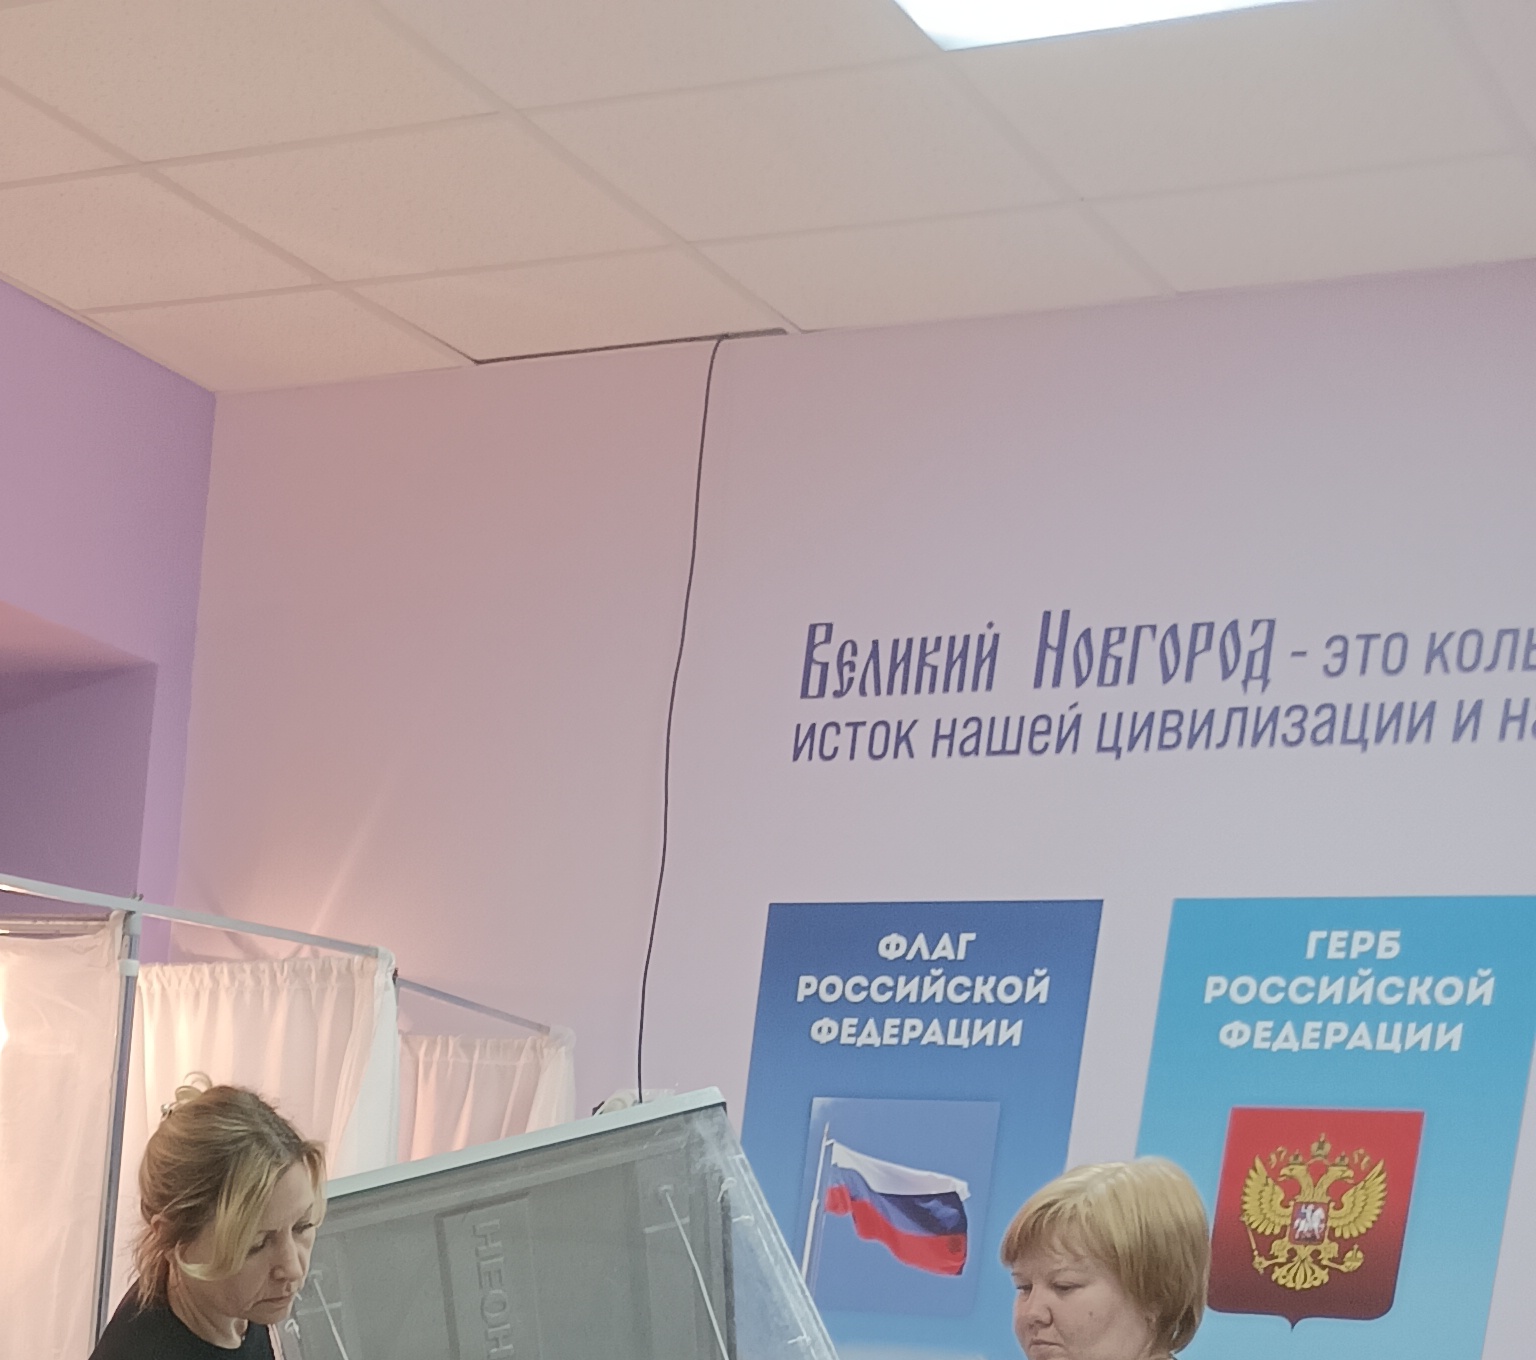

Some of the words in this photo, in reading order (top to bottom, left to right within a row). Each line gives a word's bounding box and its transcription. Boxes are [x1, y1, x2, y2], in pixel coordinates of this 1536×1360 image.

[1290, 650, 1308, 658] -
[1498, 697, 1536, 743] н
[877, 932, 977, 961] ФЛАГ
[1305, 929, 1402, 960] ГЕРБ
[796, 969, 1051, 1005] РОССИЙСКОЙ
[1203, 969, 1496, 1007] РОССИЙСКОЙ
[810, 1017, 1024, 1048] ФЕДЕРАЦИИ
[1219, 1020, 1465, 1053] ФЕДЕРАЦИИ
